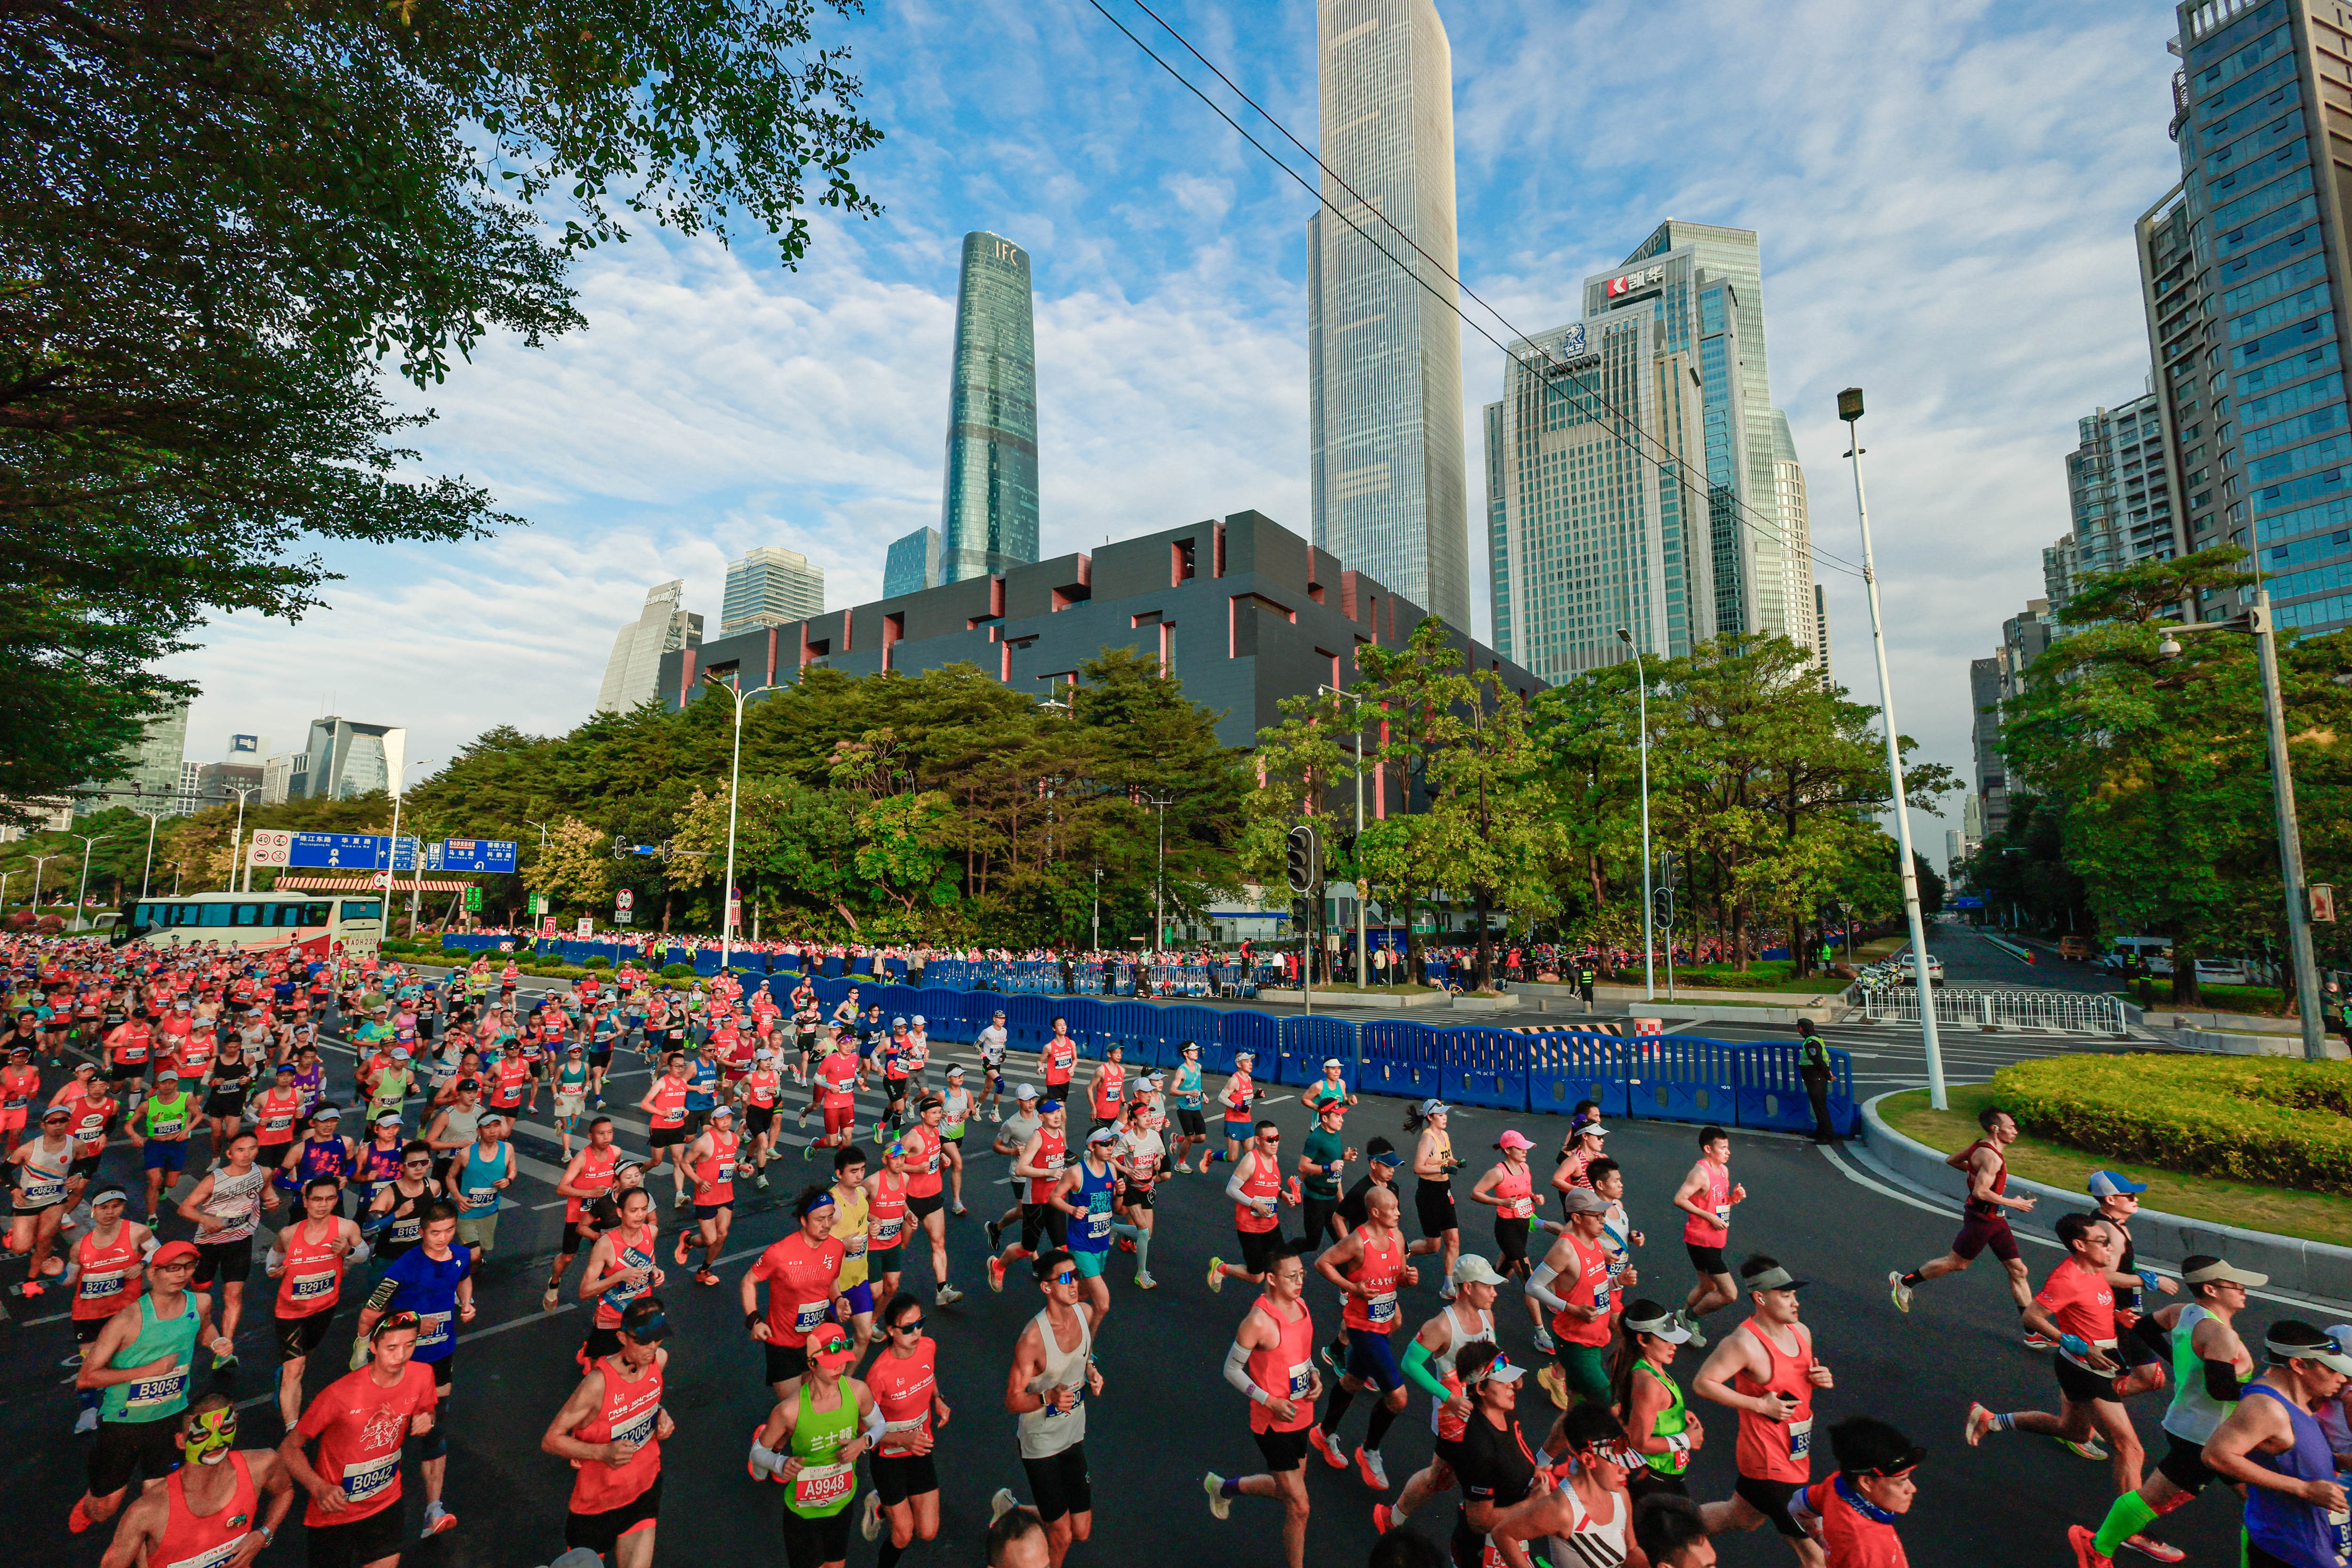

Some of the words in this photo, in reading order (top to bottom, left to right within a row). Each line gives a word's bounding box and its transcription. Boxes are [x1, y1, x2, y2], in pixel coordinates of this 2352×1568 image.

[996, 240, 1017, 265] IFC
[1629, 264, 1664, 290] 凯华
[1139, 1154, 1154, 1163] B9442
[32, 1186, 57, 1194] C0823
[398, 1226, 420, 1236] B163
[884, 1225, 900, 1234] B2473
[623, 1247, 652, 1266] Marat
[87, 1280, 117, 1291] B2720
[300, 1279, 330, 1292] B2913
[1375, 1301, 1394, 1315] B0627
[803, 1310, 825, 1323] B3034
[140, 1378, 179, 1396] B3056
[352, 1466, 392, 1490] B0942
[806, 1476, 845, 1496] A9948
